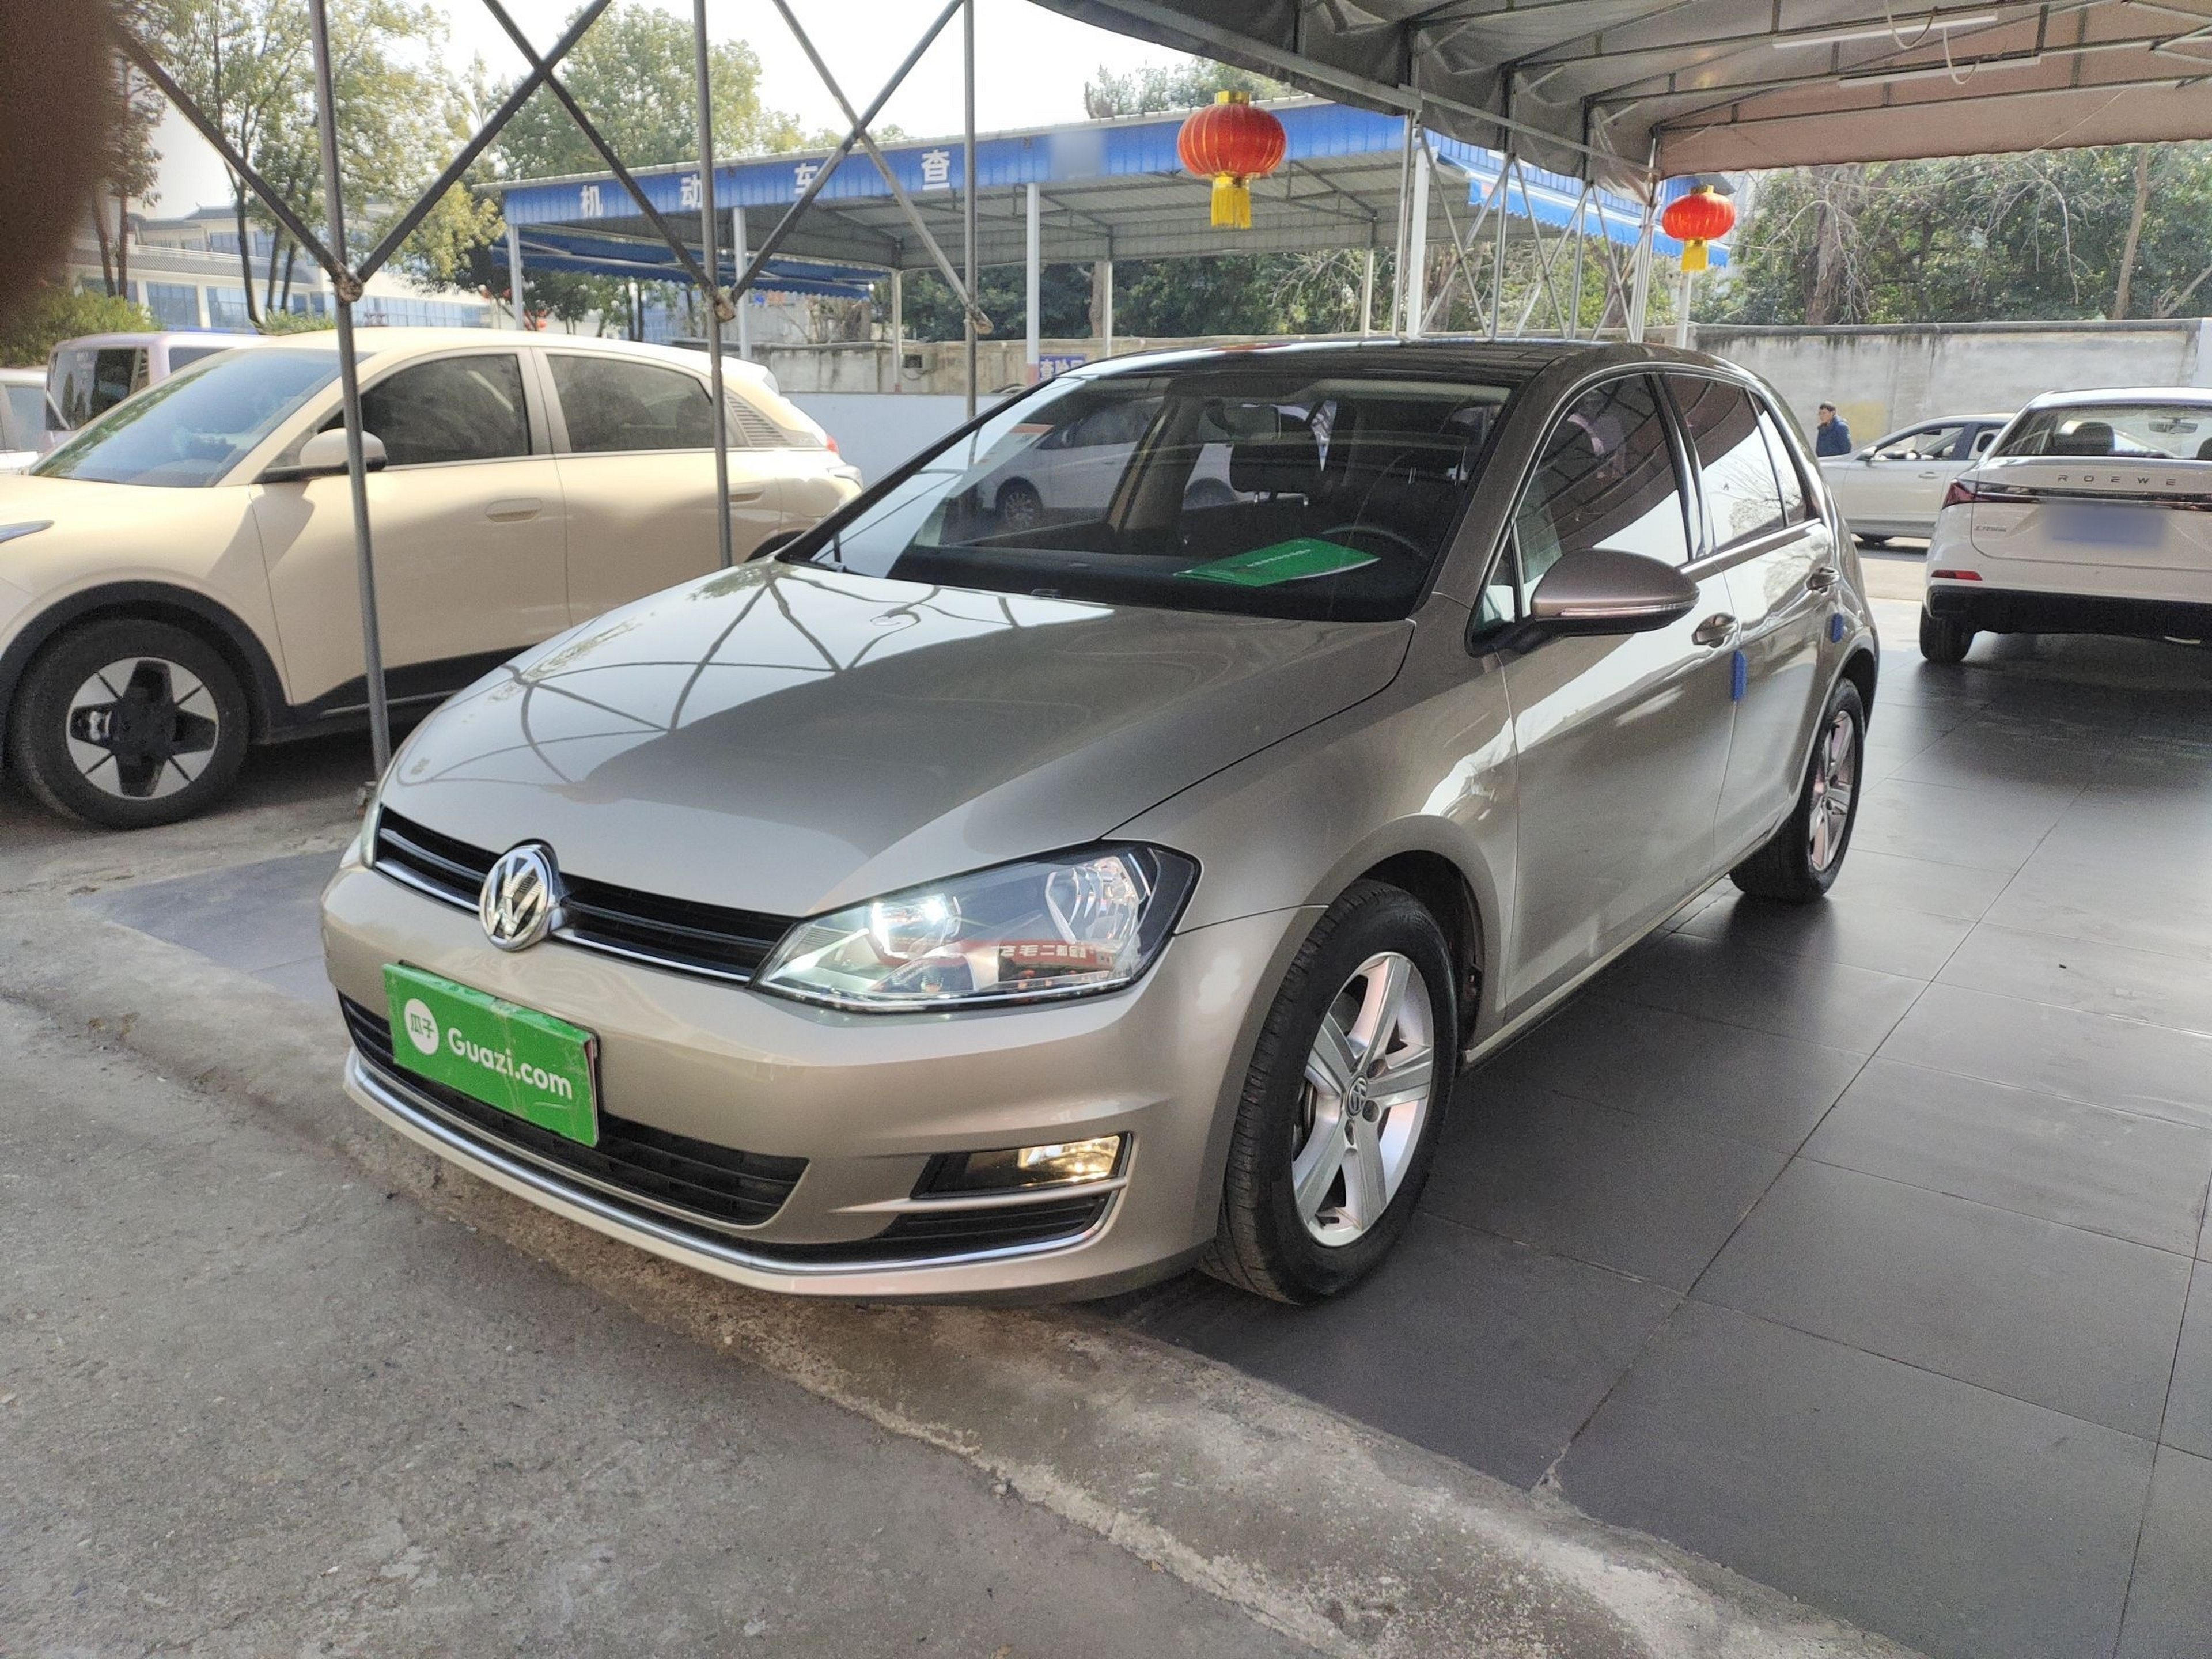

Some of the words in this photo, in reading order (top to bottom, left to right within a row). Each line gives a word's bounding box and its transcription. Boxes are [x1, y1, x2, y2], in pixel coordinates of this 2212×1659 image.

[2057, 474, 2177, 486] ROEWE
[411, 1013, 435, 1039] 瓜子
[447, 1027, 573, 1100] Guazi.com
